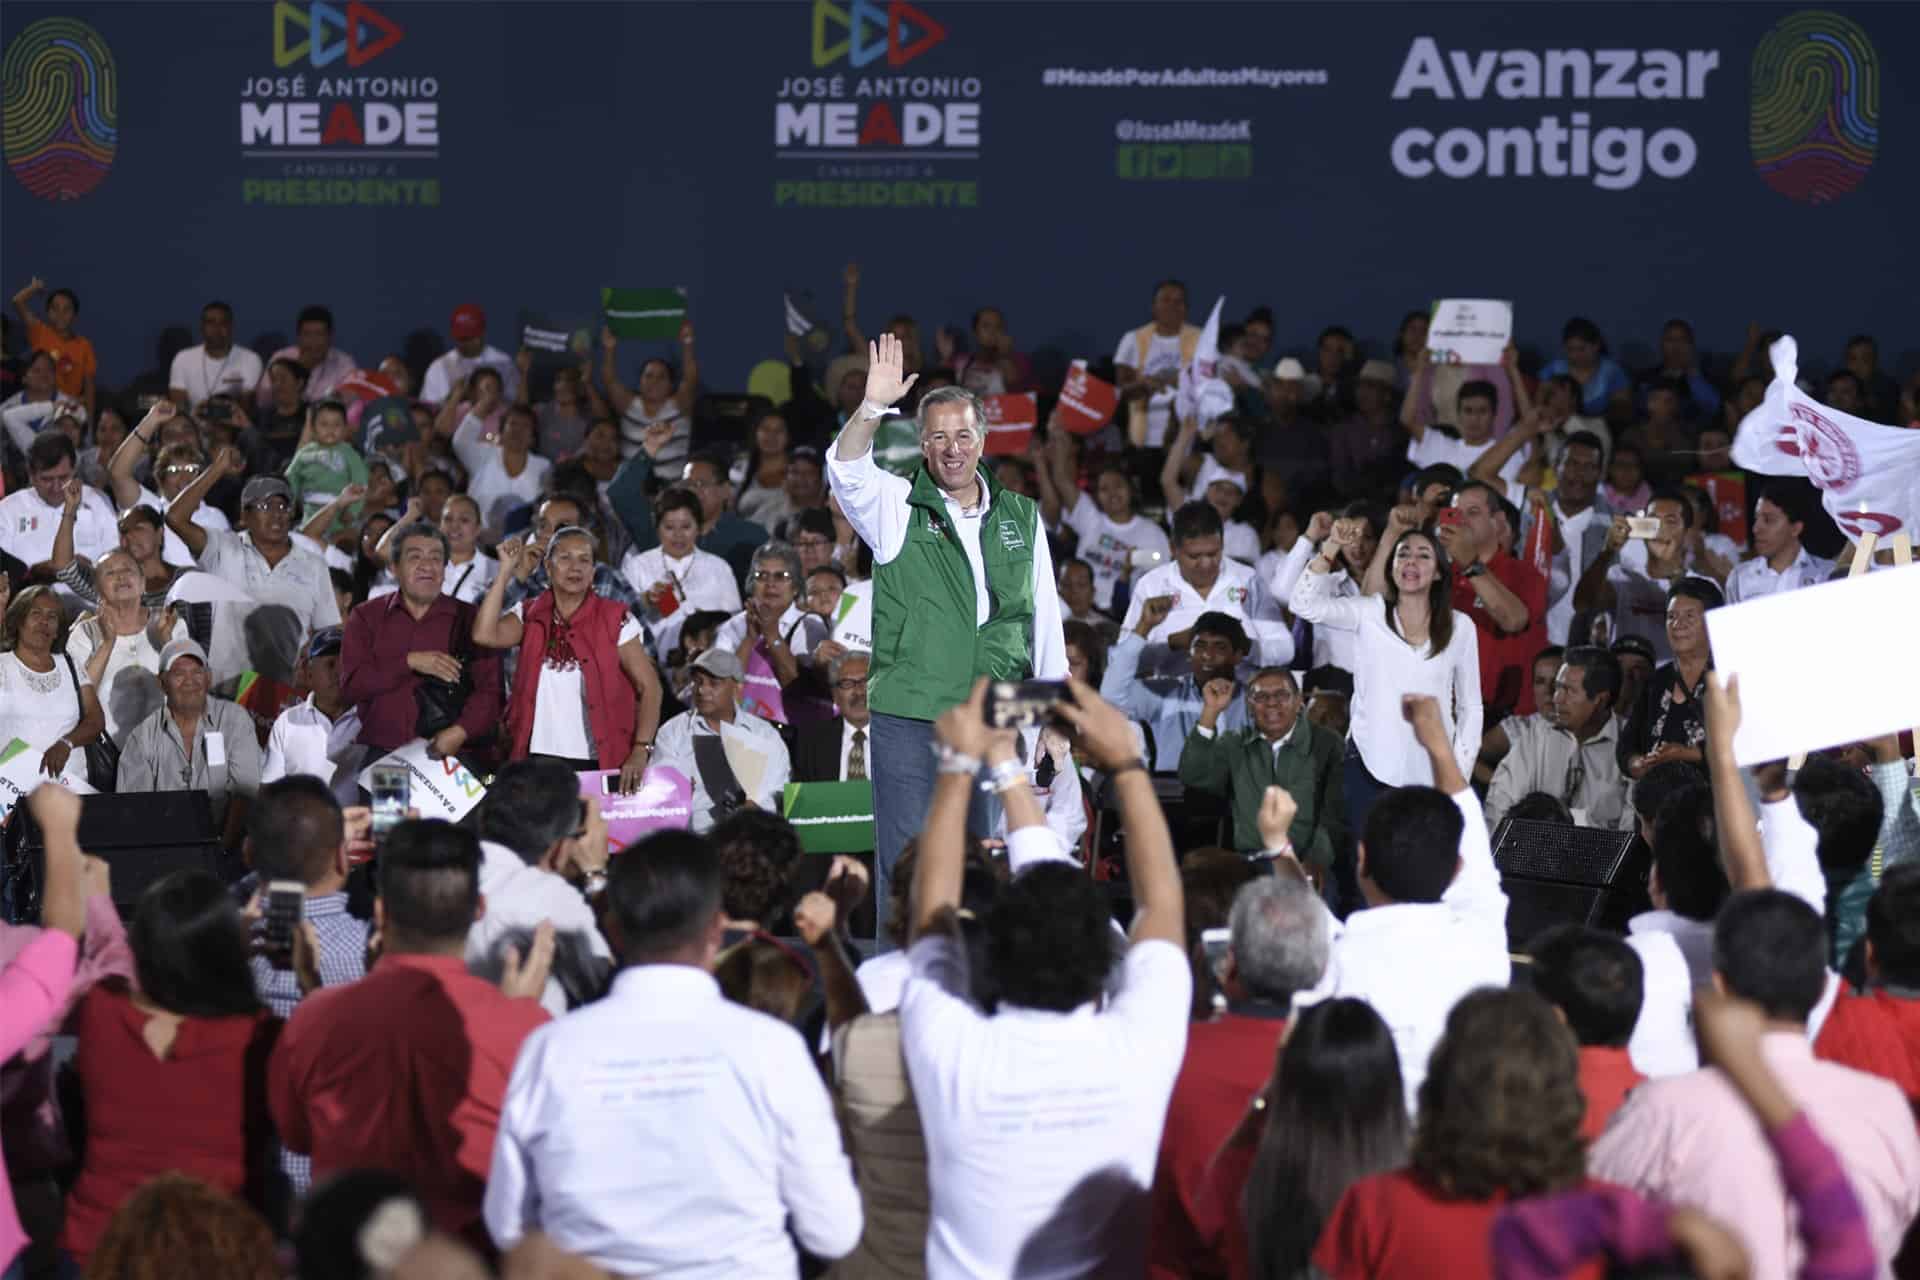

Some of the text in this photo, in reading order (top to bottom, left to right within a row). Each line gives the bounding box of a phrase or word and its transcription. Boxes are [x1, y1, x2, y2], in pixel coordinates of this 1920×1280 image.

[1042, 68, 1328, 88] #MeadePorAdultosMayores
[1391, 36, 1720, 99] Avanzar
[241, 74, 439, 97] JOSÉ ANTONIO
[777, 74, 982, 97] JOSÉ ANTONIO
[241, 102, 439, 145] MEADE
[775, 102, 980, 146] MEADE
[1390, 112, 1698, 190] contigo
[242, 179, 440, 206] PRESIDENTE
[775, 181, 977, 207] PRESIDENTE
